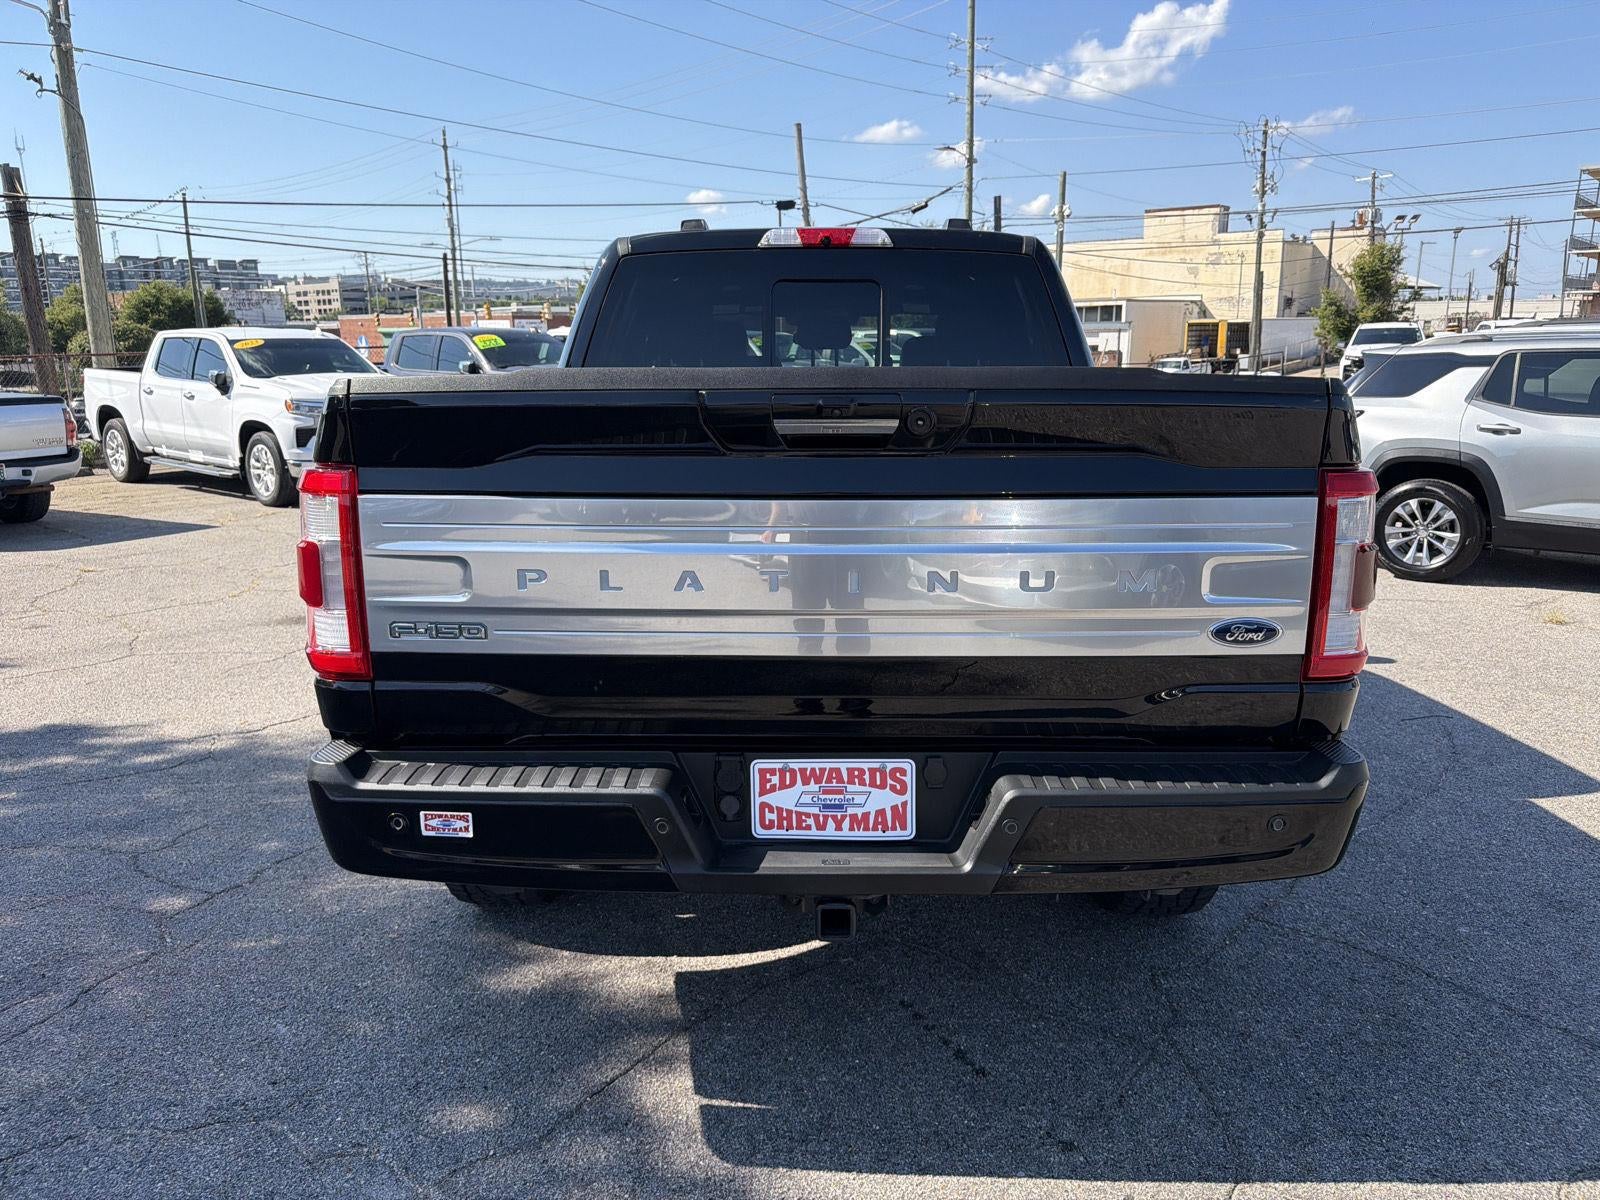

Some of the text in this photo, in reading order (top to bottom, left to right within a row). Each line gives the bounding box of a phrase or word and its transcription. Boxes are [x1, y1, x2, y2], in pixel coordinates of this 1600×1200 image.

[516, 568, 1159, 594] PLATINUM
[389, 620, 488, 640] F-150
[1225, 624, 1267, 641] Ford
[757, 766, 909, 798] EDWARDS
[810, 795, 856, 804] Chevrolet
[424, 813, 470, 823] EDWARDS
[758, 799, 909, 832] CHEVYMAN
